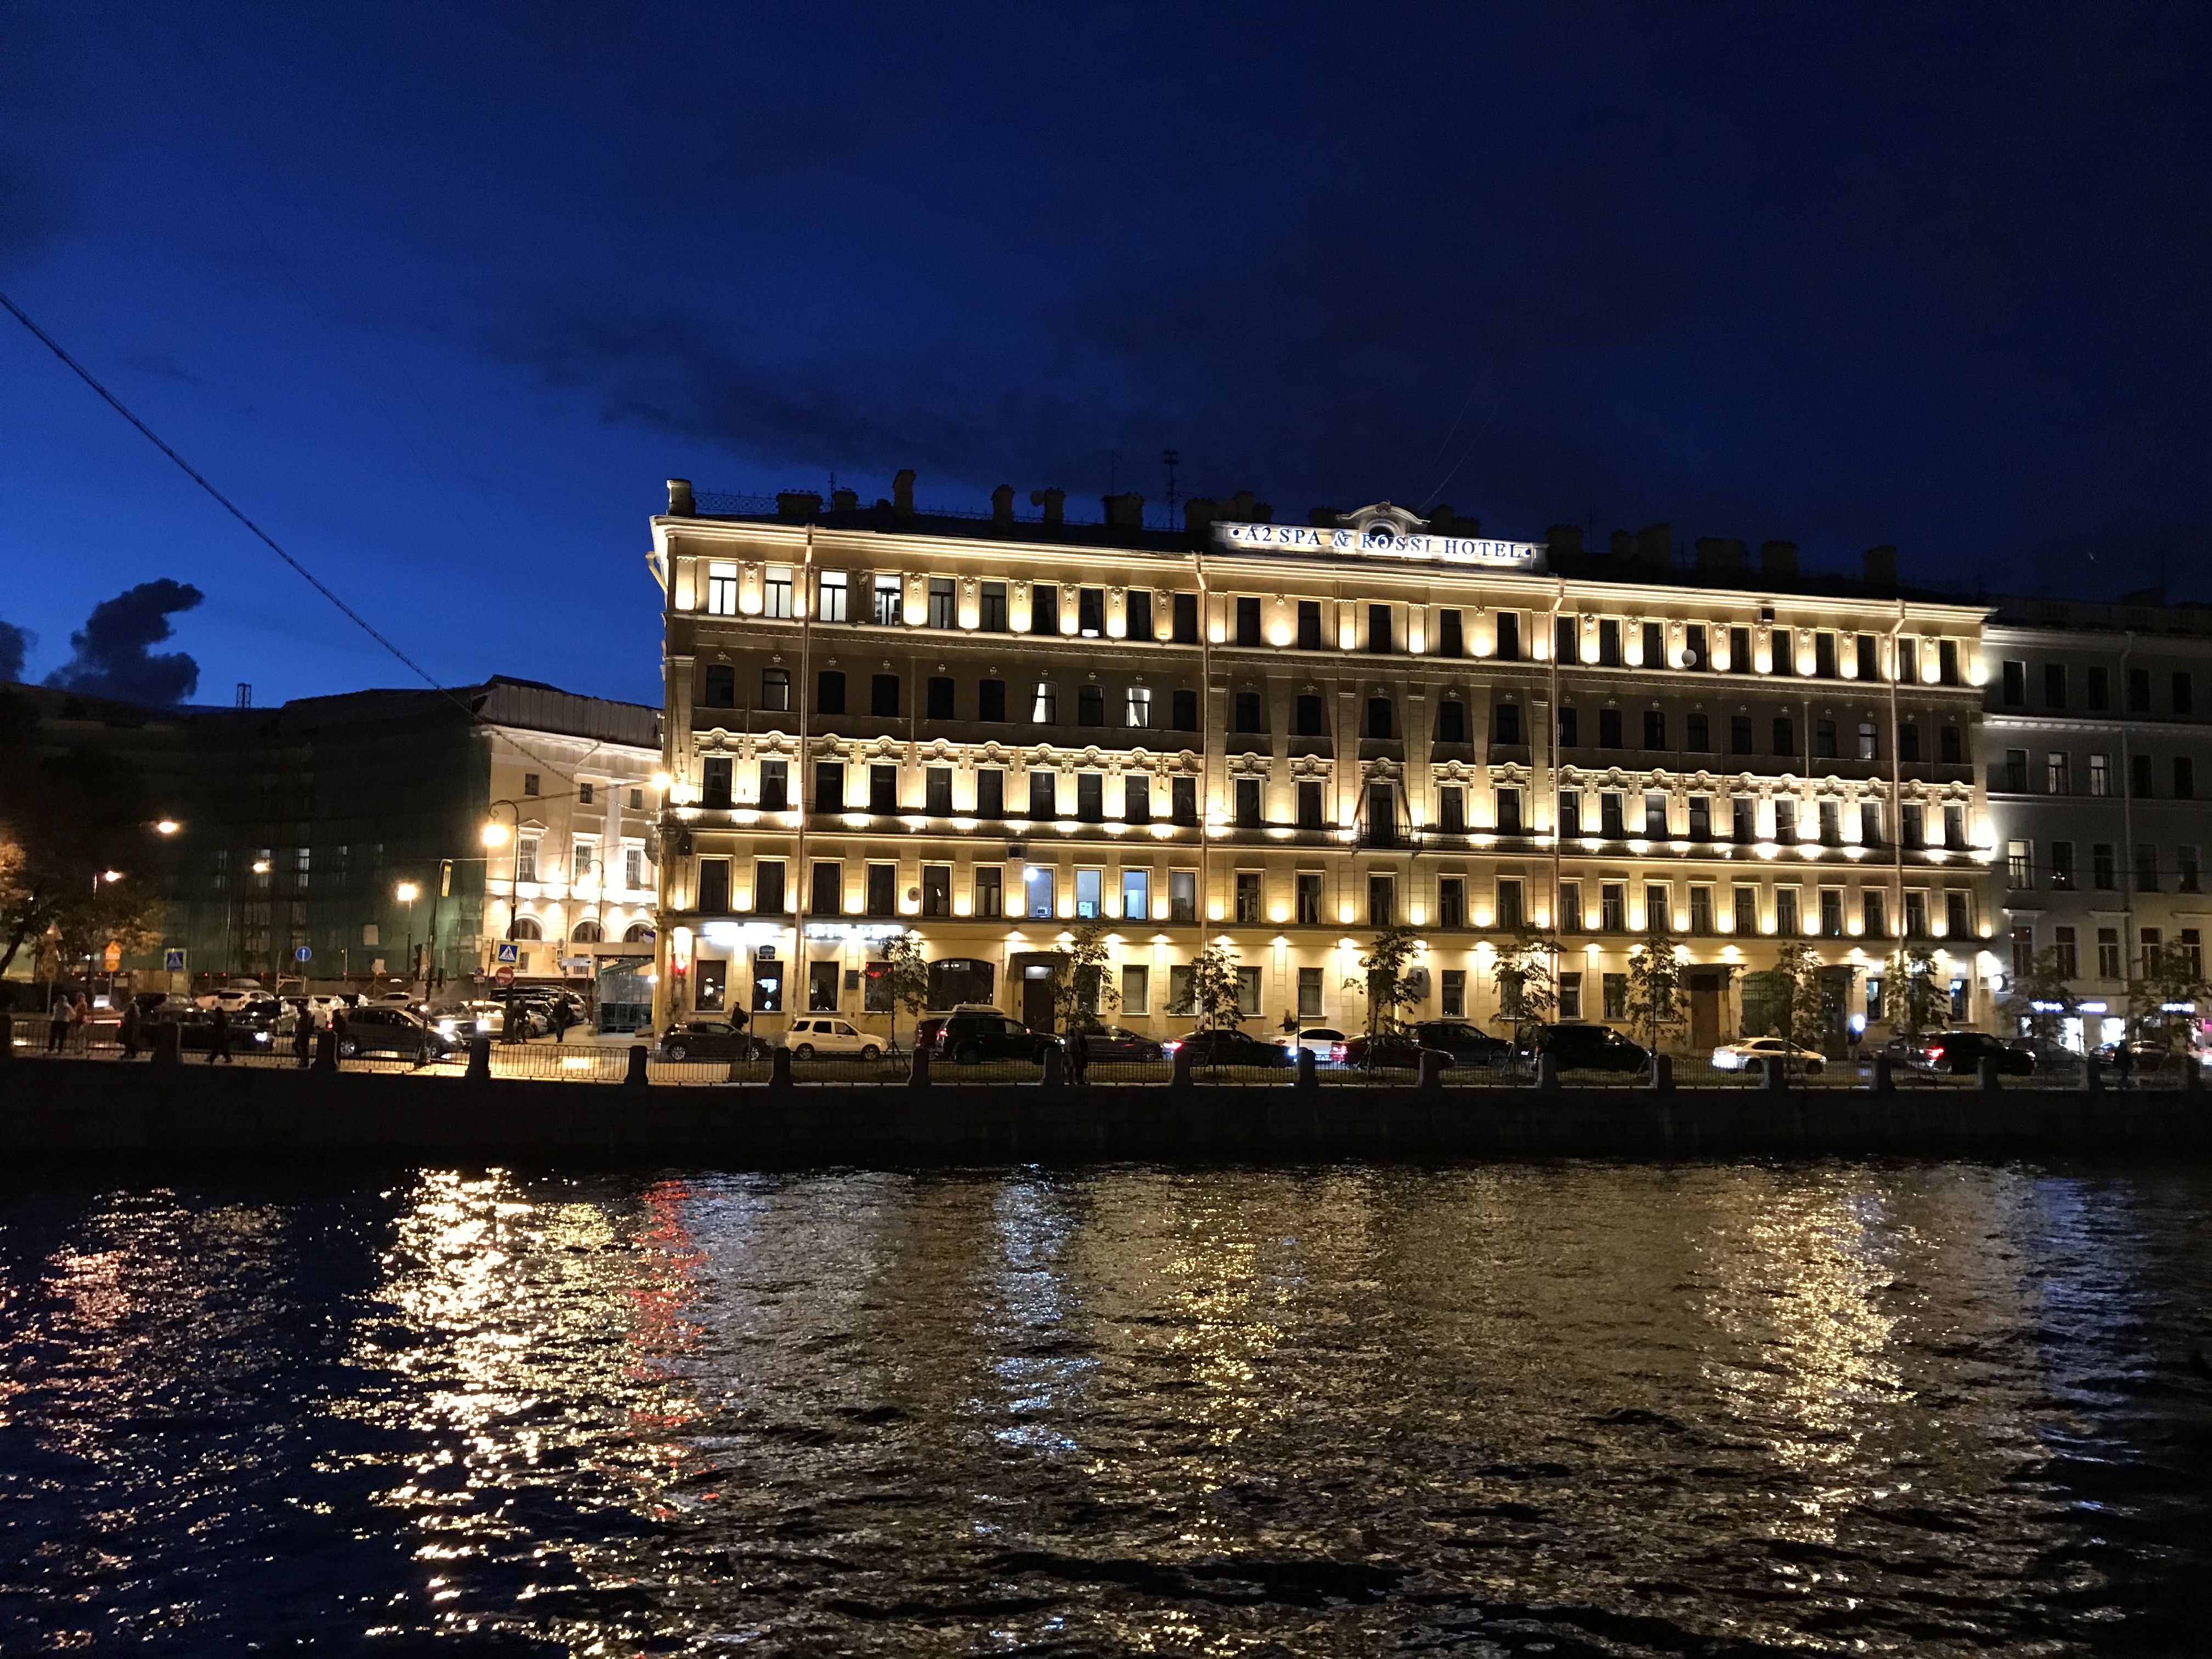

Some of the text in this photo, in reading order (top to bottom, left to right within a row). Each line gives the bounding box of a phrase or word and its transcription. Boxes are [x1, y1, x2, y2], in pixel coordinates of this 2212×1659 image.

[1244, 526, 1520, 558] A2 SPA & ROSSI HOTEL
